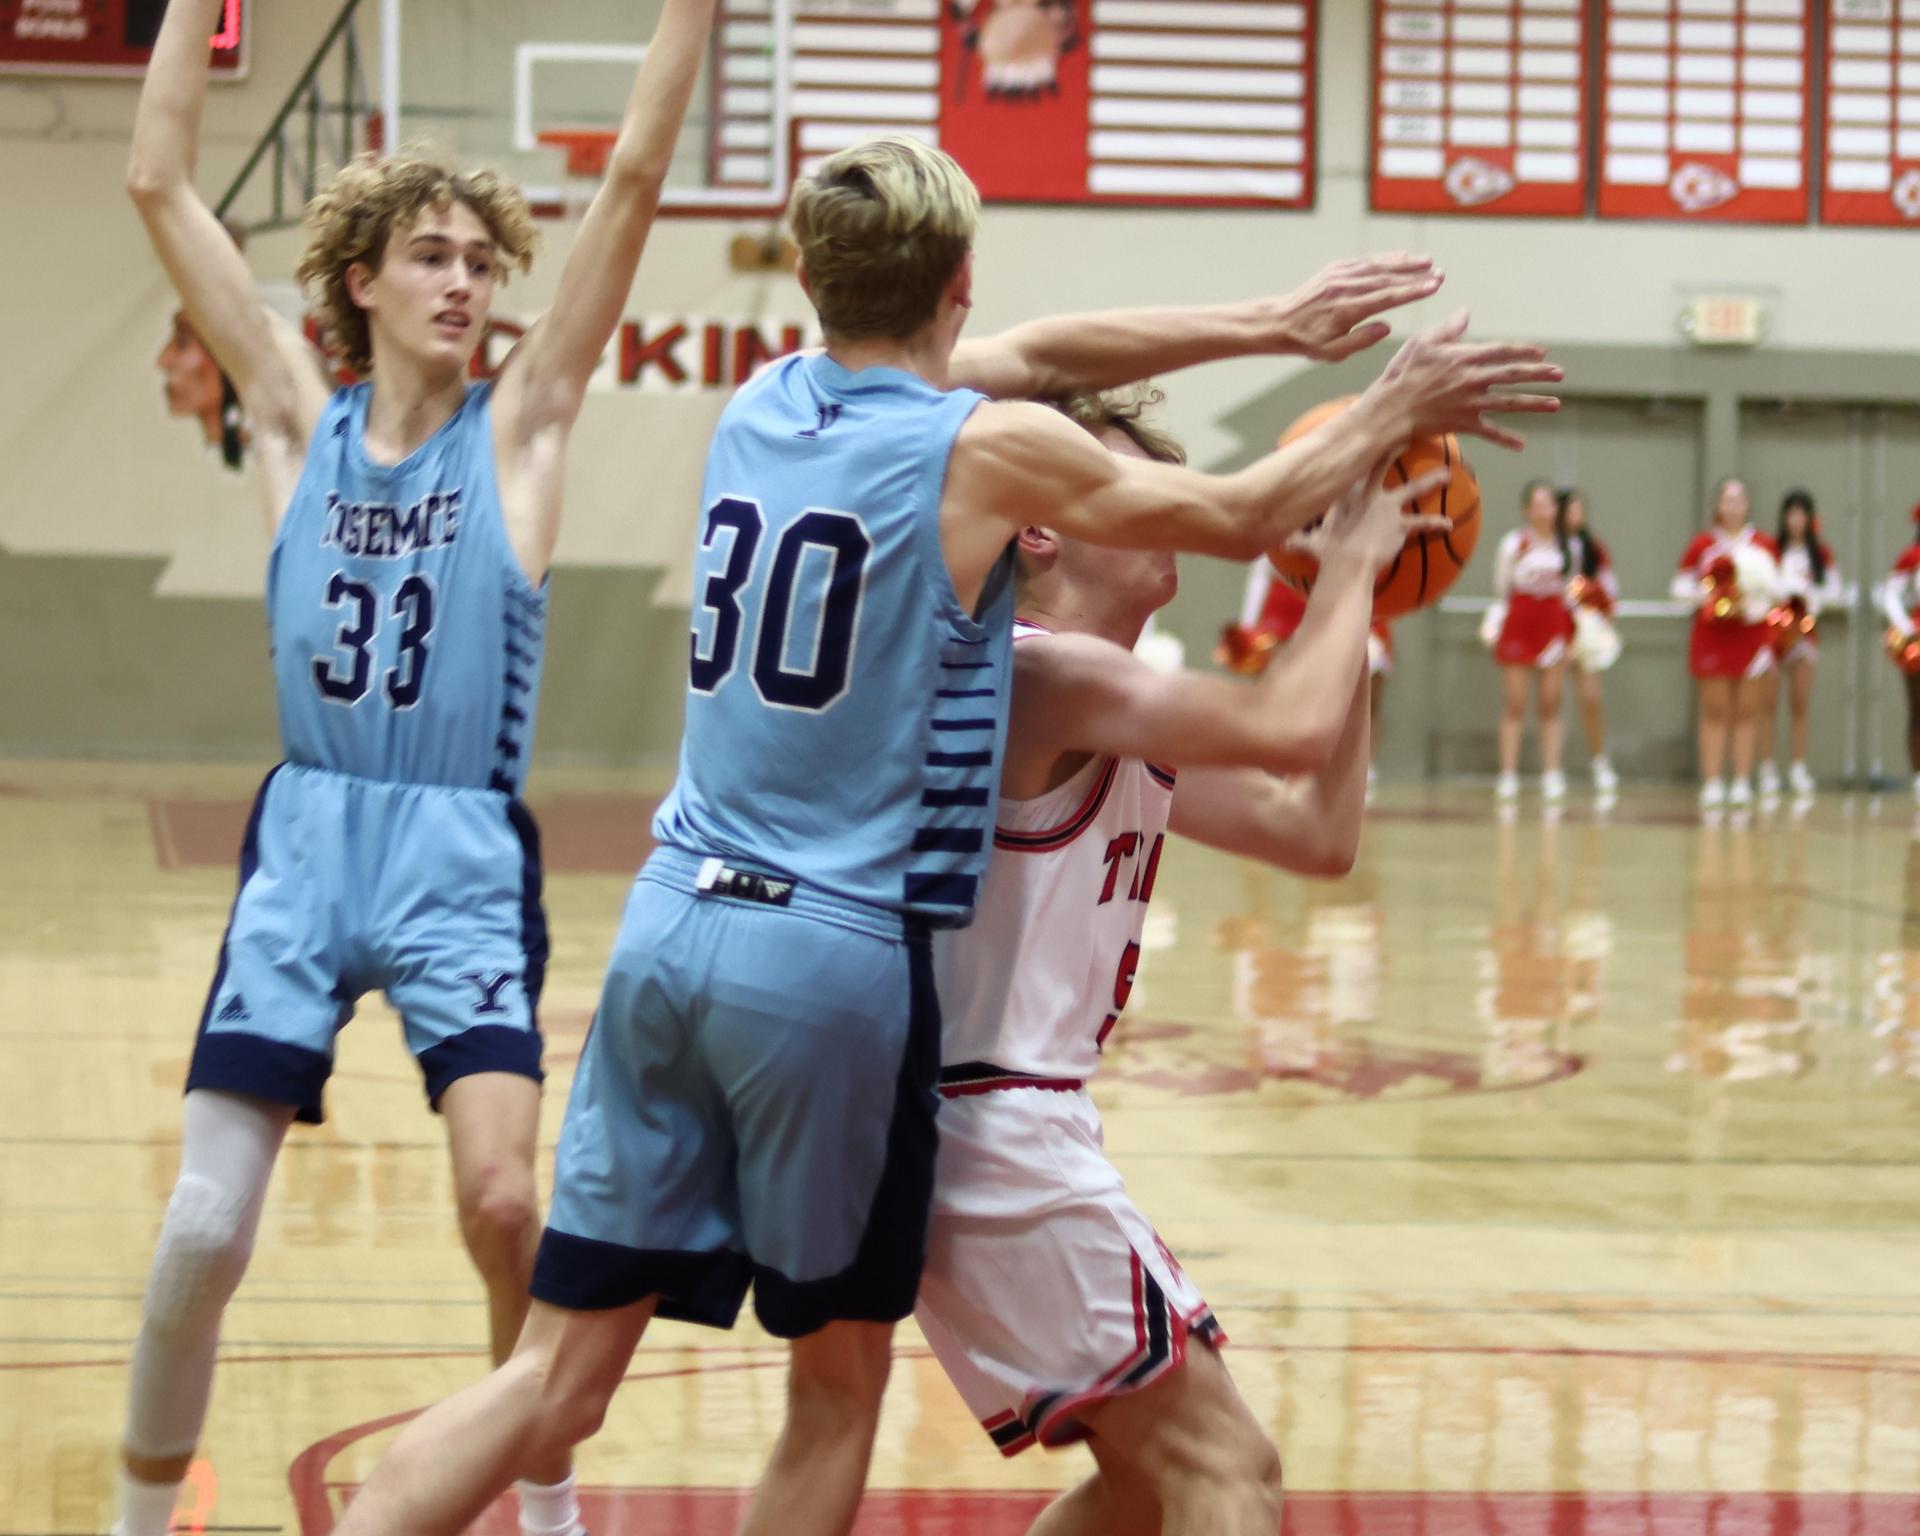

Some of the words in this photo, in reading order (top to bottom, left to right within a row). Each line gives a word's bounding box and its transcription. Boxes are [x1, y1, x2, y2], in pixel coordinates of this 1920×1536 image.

[309, 568, 438, 711] 33
[689, 493, 875, 715] 30
[455, 968, 516, 1015] Y
